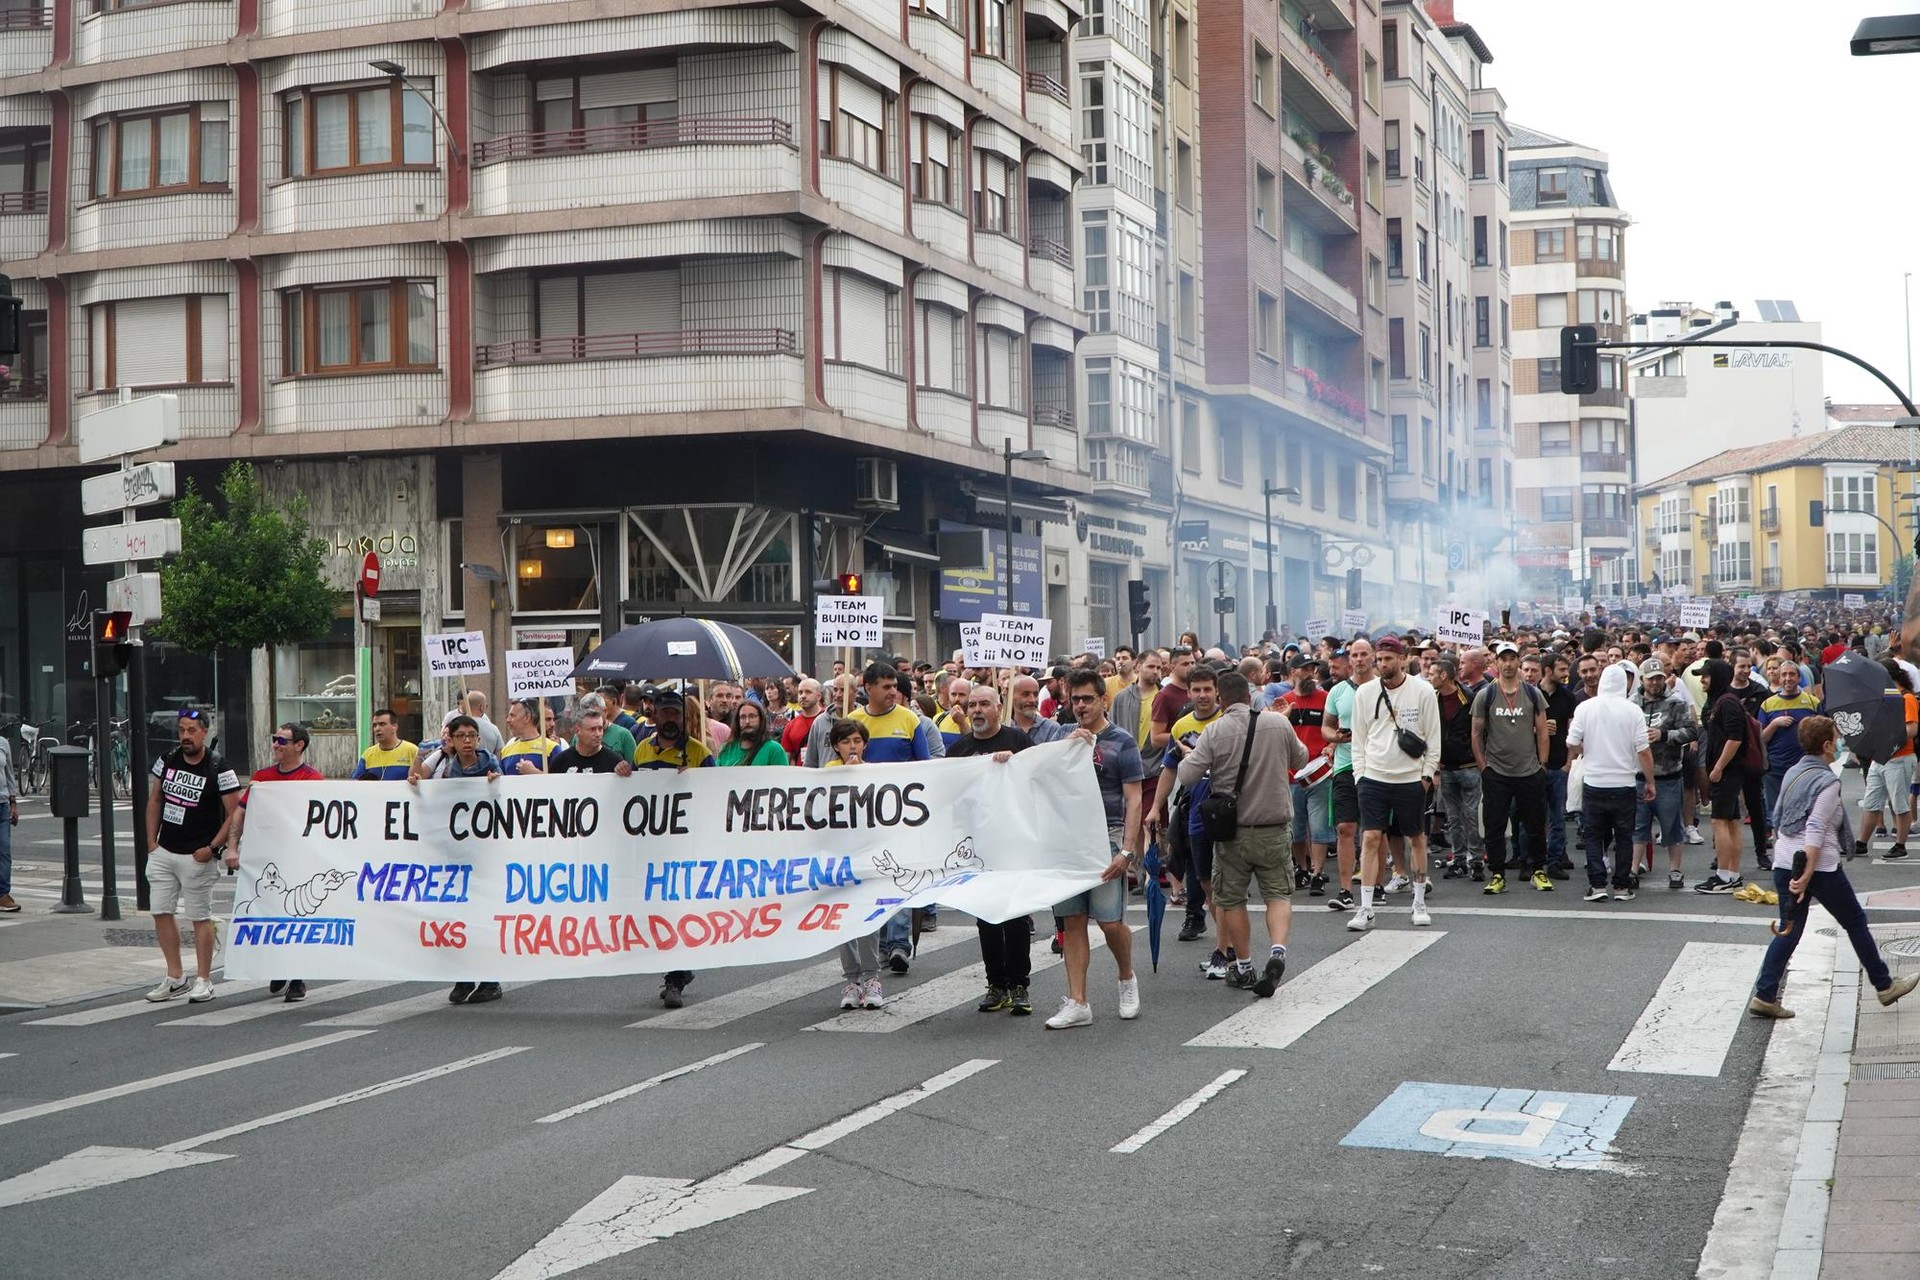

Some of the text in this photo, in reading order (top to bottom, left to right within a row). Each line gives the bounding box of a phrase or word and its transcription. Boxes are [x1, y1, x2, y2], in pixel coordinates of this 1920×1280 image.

[380, 558, 417, 569] joyas
[834, 600, 866, 610] TEAM
[822, 614, 878, 624] BUILDING
[999, 620, 1033, 631] TEAM
[1450, 611, 1470, 626] IPC
[837, 630, 860, 641] NO
[985, 632, 1045, 646] BUILDING
[1438, 626, 1481, 641] Sin trampas
[441, 638, 469, 655] IPC
[1001, 648, 1025, 660] NO
[431, 659, 486, 671] Sin trampas
[514, 679, 570, 693] JORNADA
[176, 772, 204, 788] POLLA
[163, 781, 199, 800] RECORDS
[302, 782, 930, 841] POR EL CONVENIO QUE MERECEMOS
[357, 862, 473, 903] MEREZI
[506, 862, 609, 903] DUGUN
[644, 856, 861, 901] HITZARMENA
[234, 922, 354, 946] MICHELIN
[419, 903, 850, 957] LXS TRABAJADORXS DE
